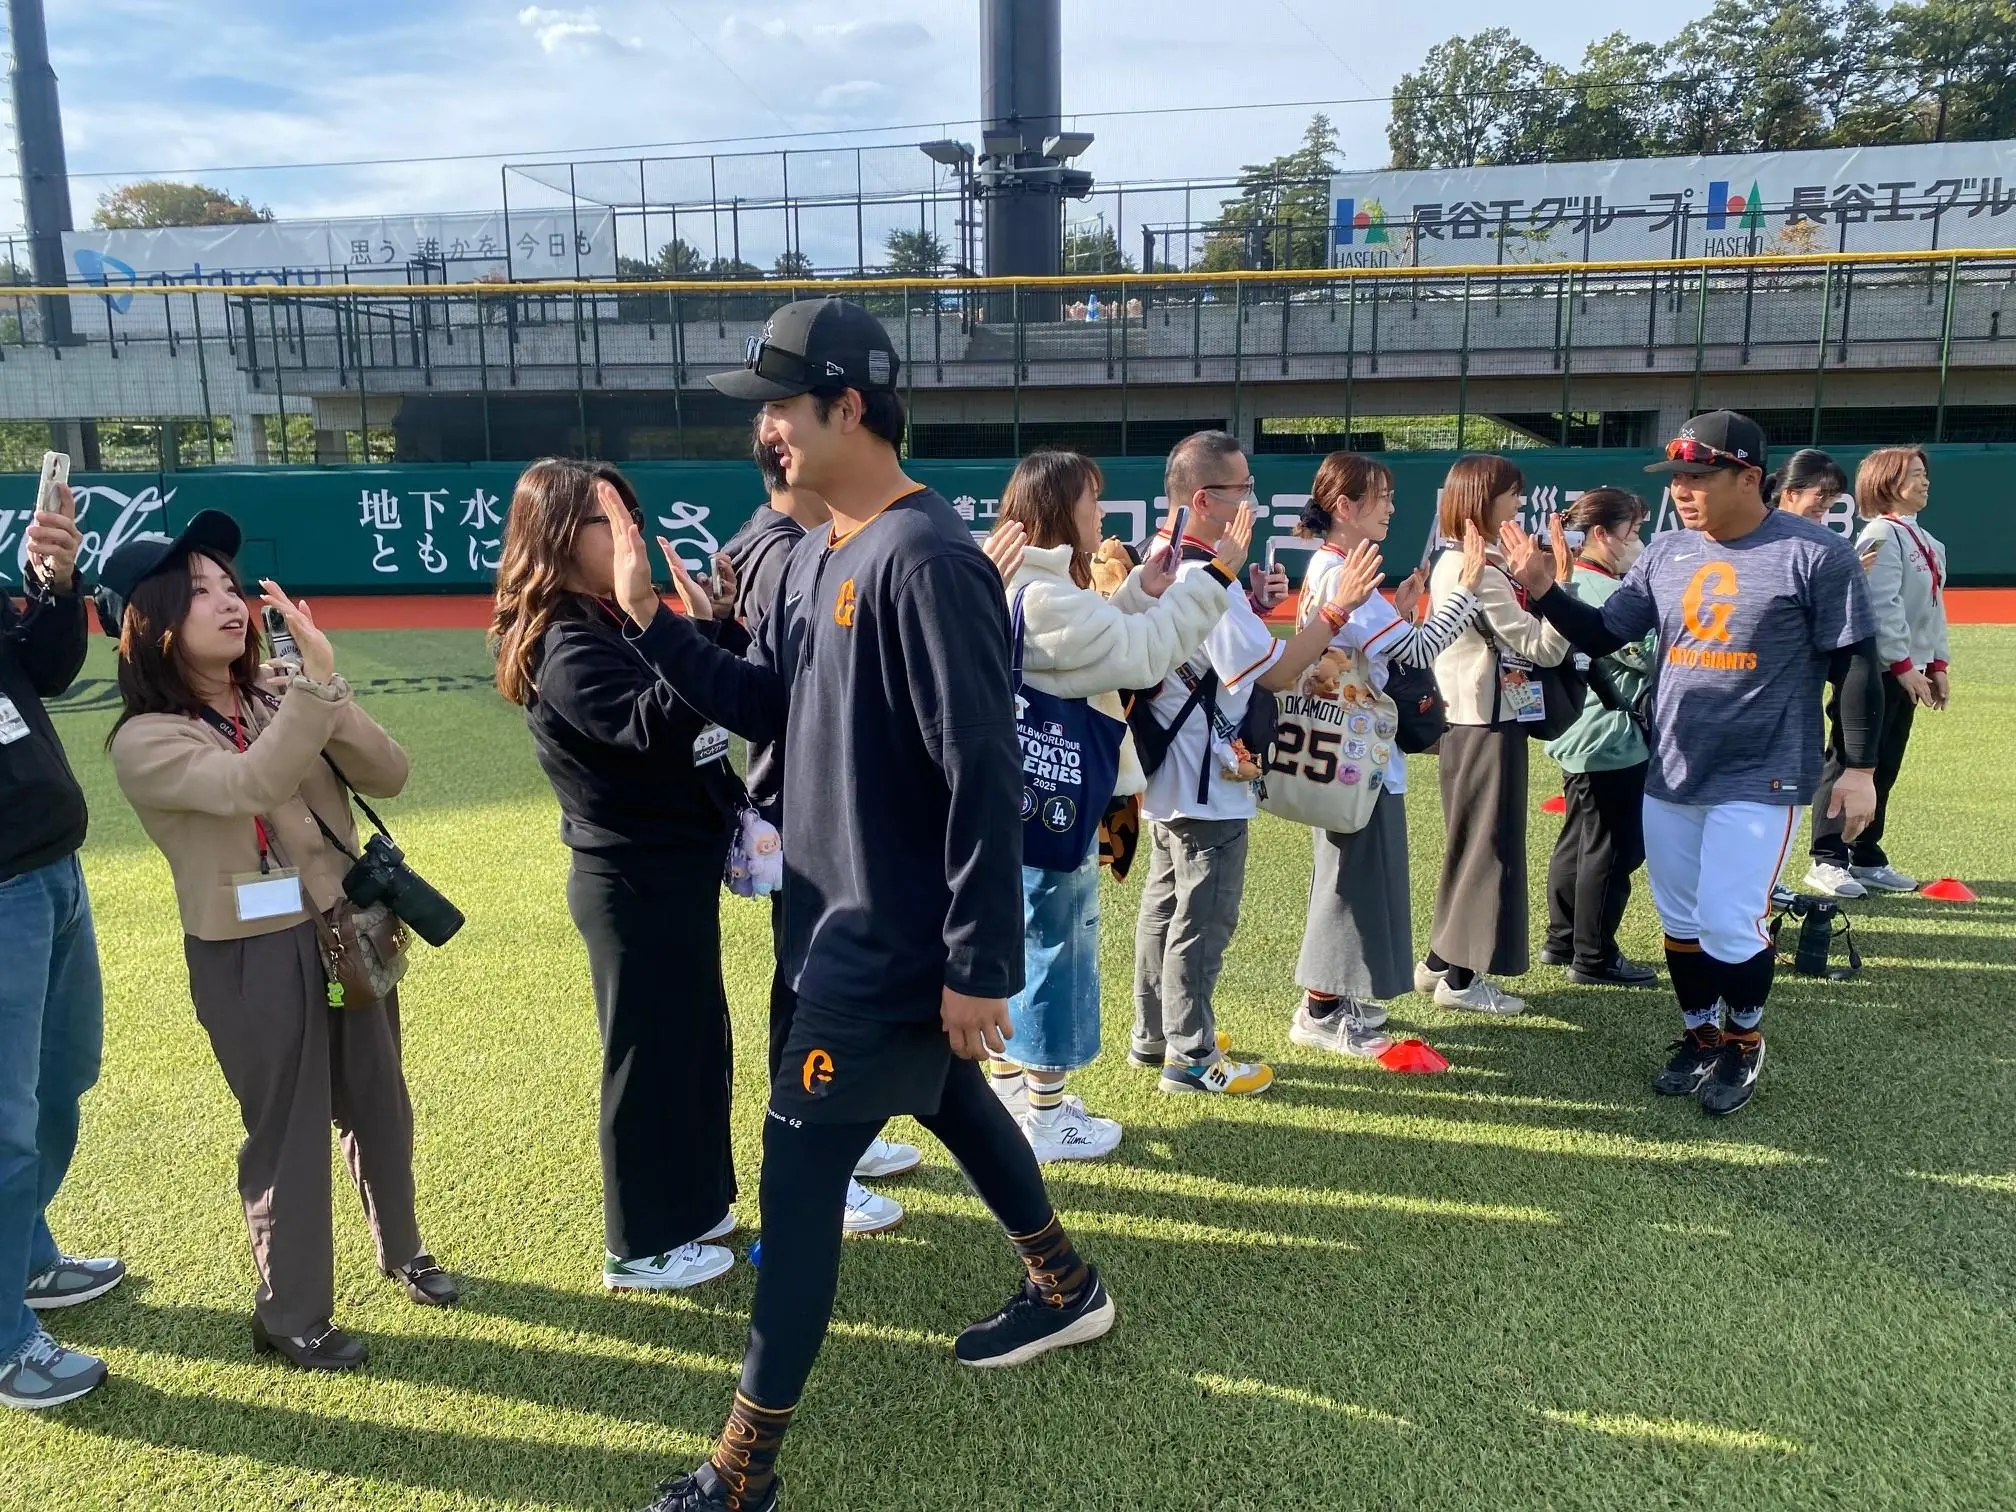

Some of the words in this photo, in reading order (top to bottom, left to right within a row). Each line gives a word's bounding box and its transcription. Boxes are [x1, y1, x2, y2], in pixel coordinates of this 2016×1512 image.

[358, 488, 503, 530] 地下水
[372, 532, 503, 574] ともに
[1681, 560, 1740, 643] G
[1700, 649, 1758, 671] GIANTS
[1284, 694, 1345, 727] OKAMOTO
[1017, 734, 1081, 768] TOKYO
[1034, 731, 1065, 748] WORLD
[1269, 721, 1342, 784] 25
[1022, 754, 1082, 785] ERIES
[1032, 777, 1057, 792] 2025
[788, 1118, 803, 1129] 62
